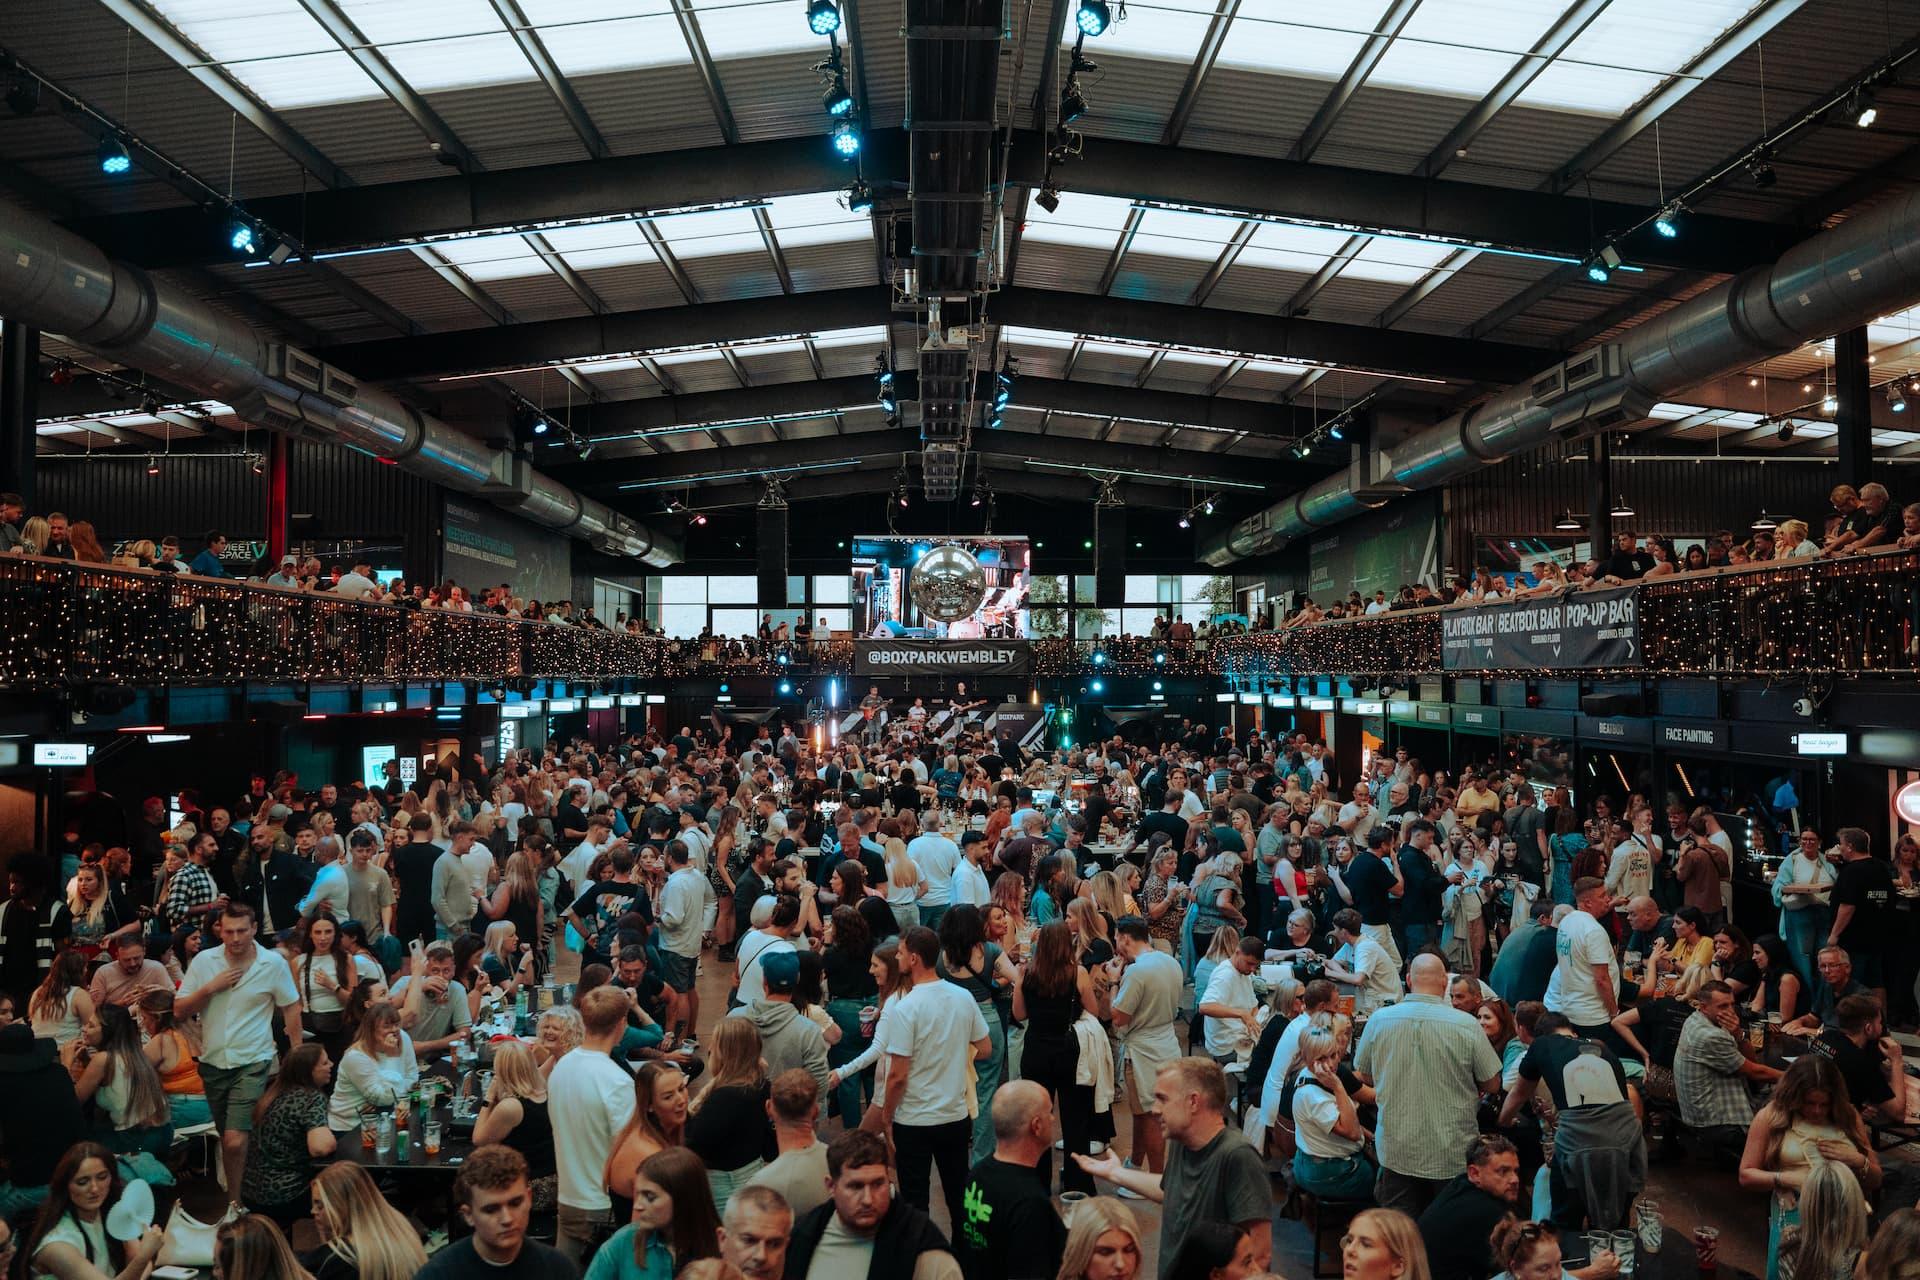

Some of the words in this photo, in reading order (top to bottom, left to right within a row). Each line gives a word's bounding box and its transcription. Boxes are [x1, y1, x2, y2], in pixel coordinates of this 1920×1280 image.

[218, 551, 252, 560] SPACE
[1443, 615, 1476, 638] PLAYBOX
[1476, 614, 1494, 635] BAR
[1498, 609, 1539, 633] BEATBOX
[1540, 606, 1560, 630] BAR
[1566, 602, 1608, 628] POP-UP
[1608, 598, 1634, 624] BAR
[1618, 627, 1634, 638] FLOOR
[868, 650, 1016, 664] @BOXPARKWEMBLEY
[1665, 727, 1682, 741] FACE
[1682, 729, 1714, 744] PAINTING
